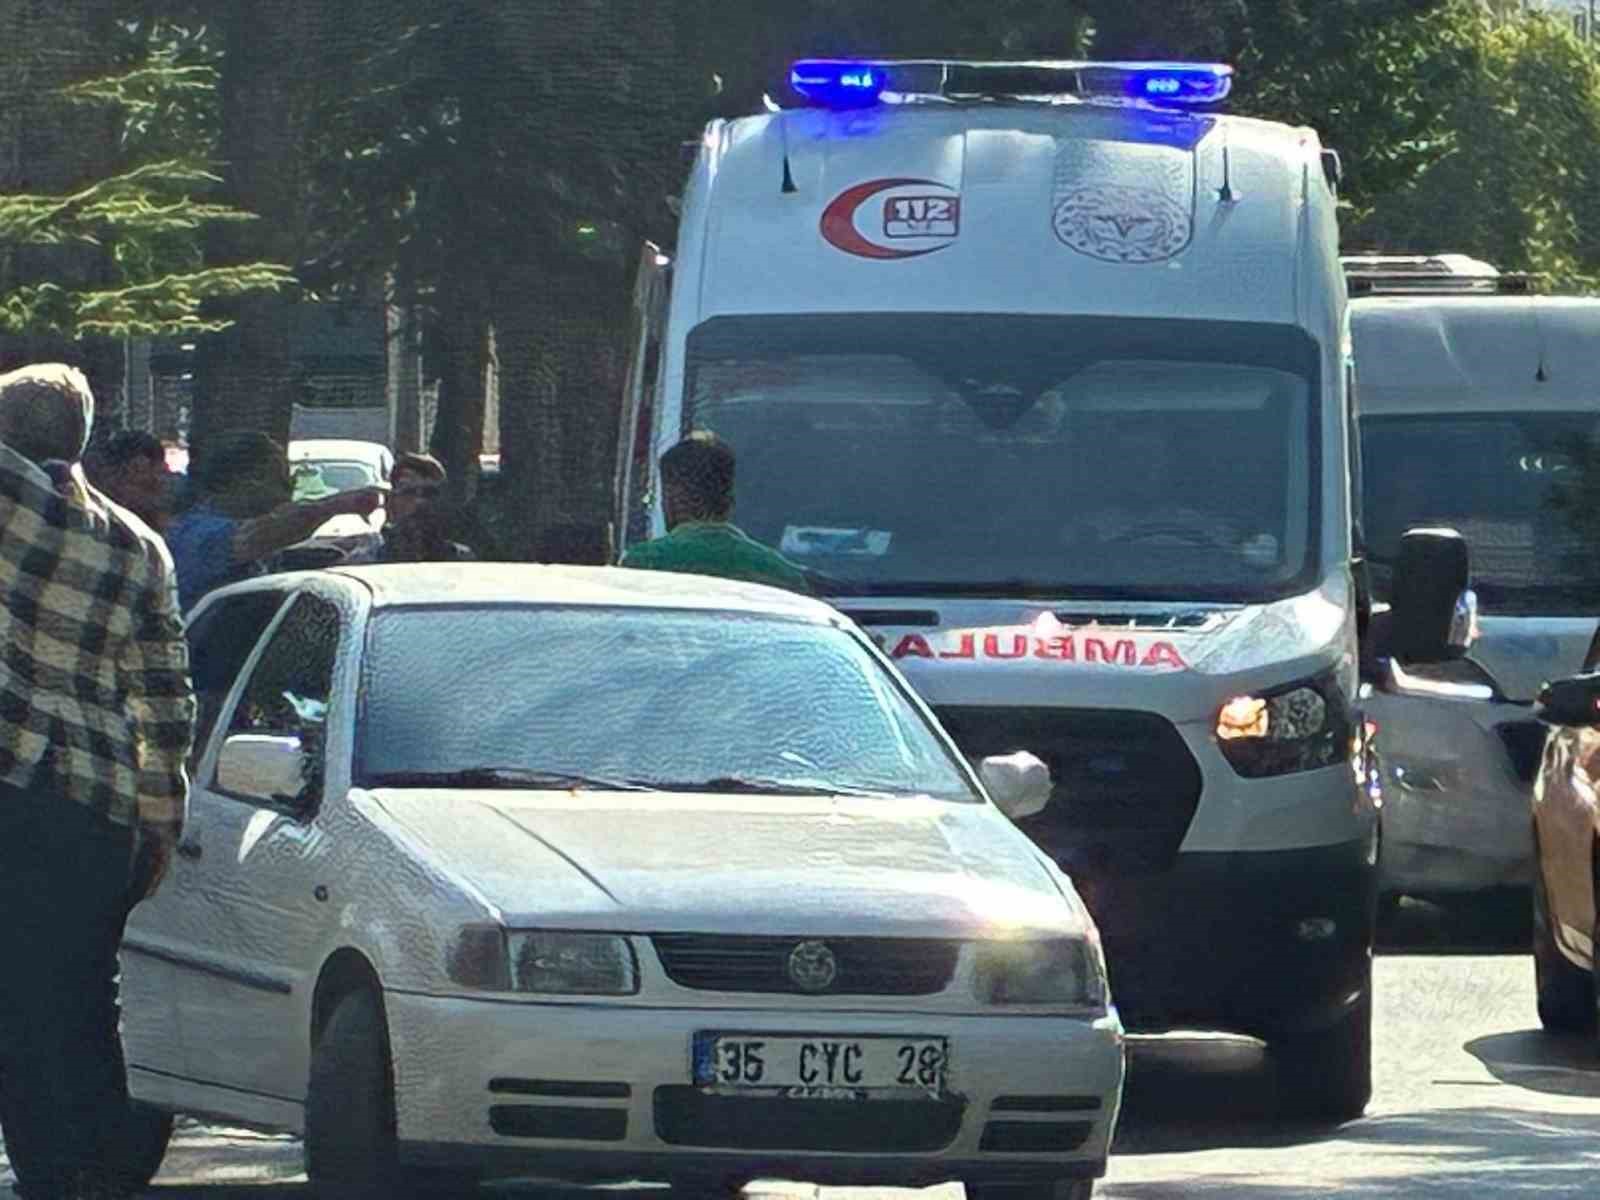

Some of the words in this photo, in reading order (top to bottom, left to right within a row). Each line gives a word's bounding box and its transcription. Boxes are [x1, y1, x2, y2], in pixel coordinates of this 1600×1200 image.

[895, 199, 950, 222] 112
[721, 1041, 765, 1082] 35
[800, 1042, 863, 1084] CYC
